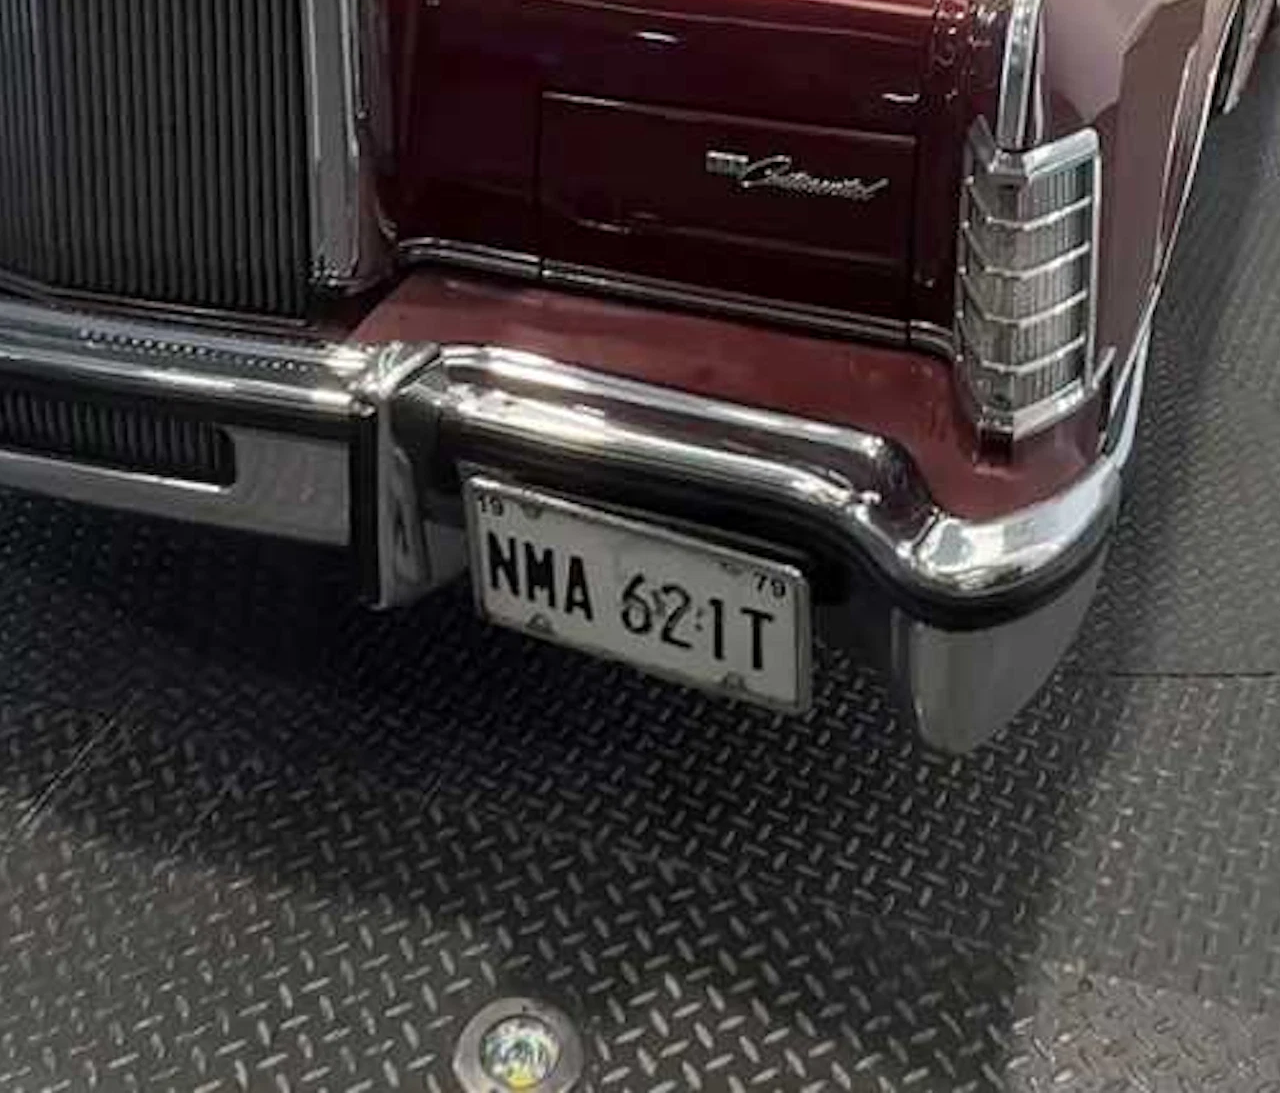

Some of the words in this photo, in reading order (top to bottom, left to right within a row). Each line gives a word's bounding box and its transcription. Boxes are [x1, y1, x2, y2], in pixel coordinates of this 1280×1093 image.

[487, 531, 594, 622] NMA
[622, 574, 776, 670] 621T
[753, 571, 788, 600] 79
